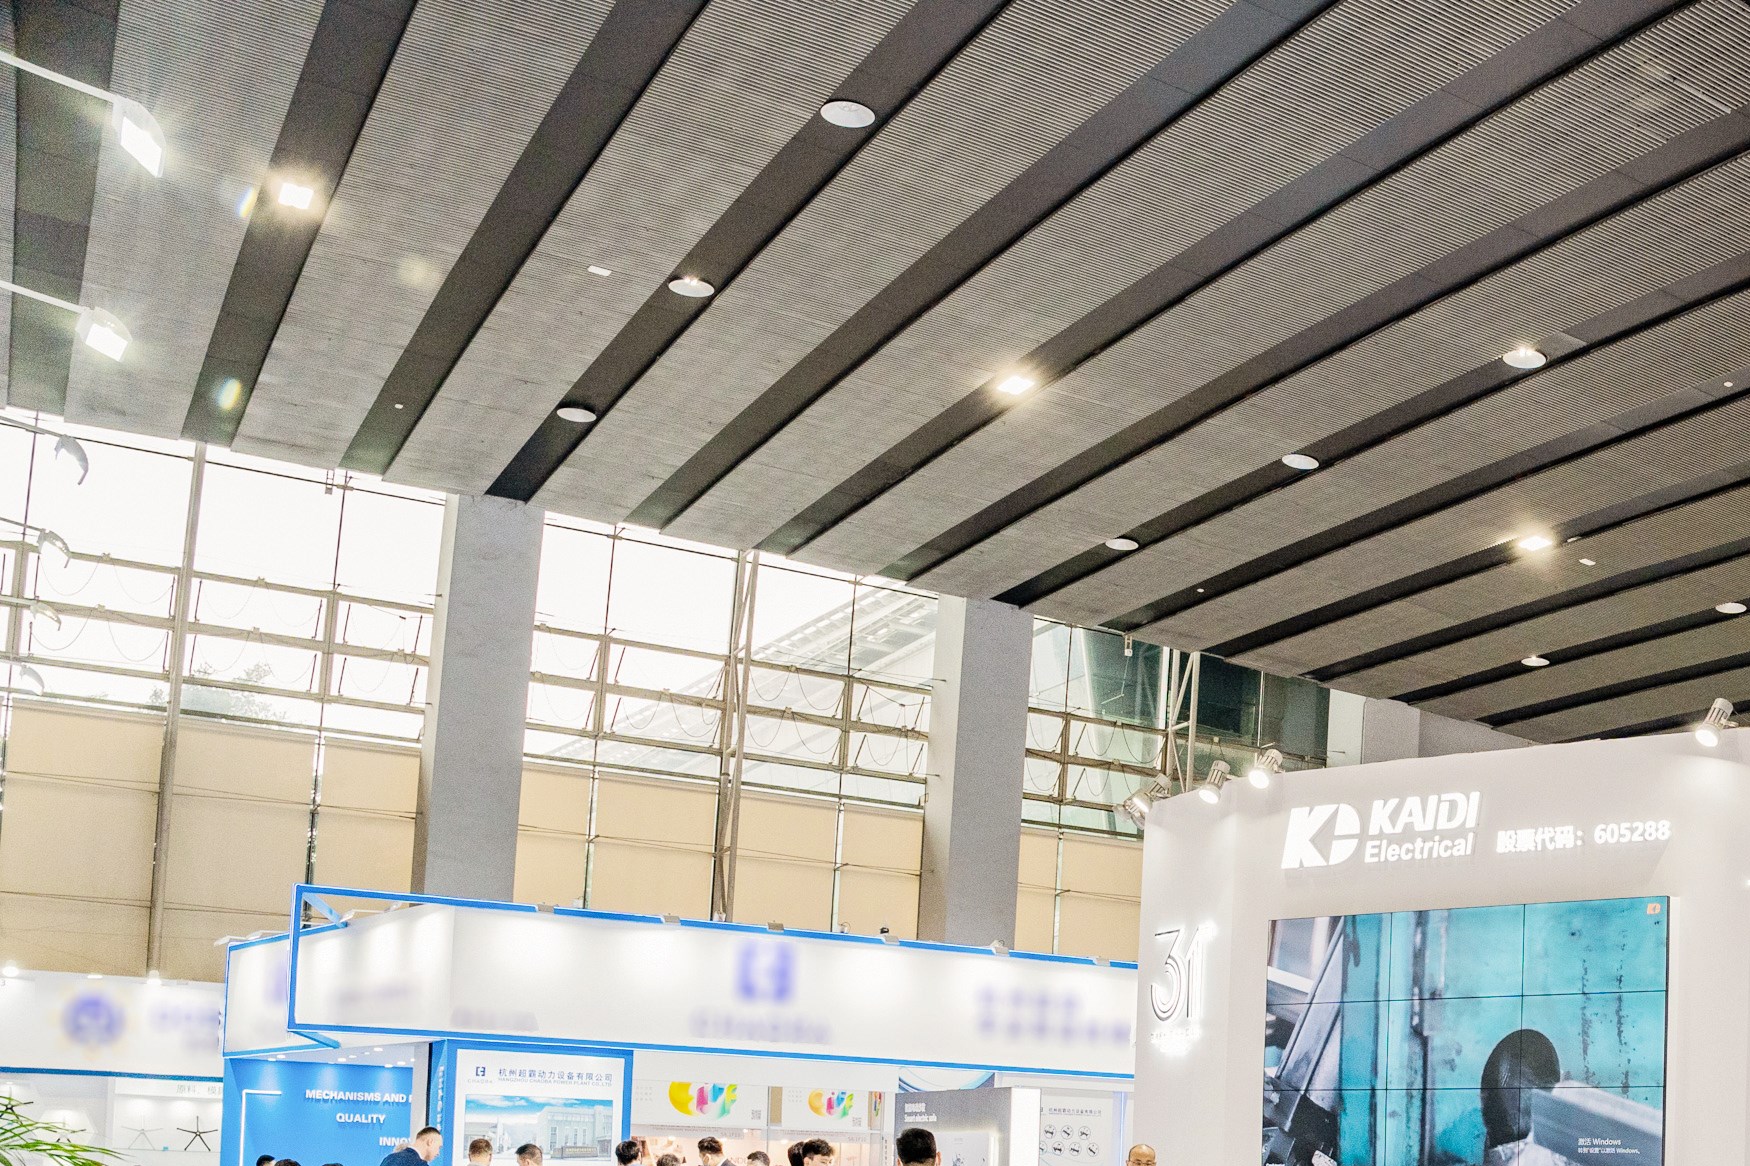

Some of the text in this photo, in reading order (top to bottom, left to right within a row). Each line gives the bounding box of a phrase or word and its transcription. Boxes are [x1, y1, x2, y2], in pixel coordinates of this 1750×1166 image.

[1368, 791, 1481, 836] KAIDI
[1594, 820, 1671, 845] 605288
[1364, 832, 1475, 863] Electrical
[305, 1089, 381, 1102] MECHANISMS
[382, 1093, 406, 1103] AND
[336, 1112, 386, 1124] QUALITY
[379, 1137, 412, 1147] INNO
[1592, 1137, 1622, 1146] Windows
